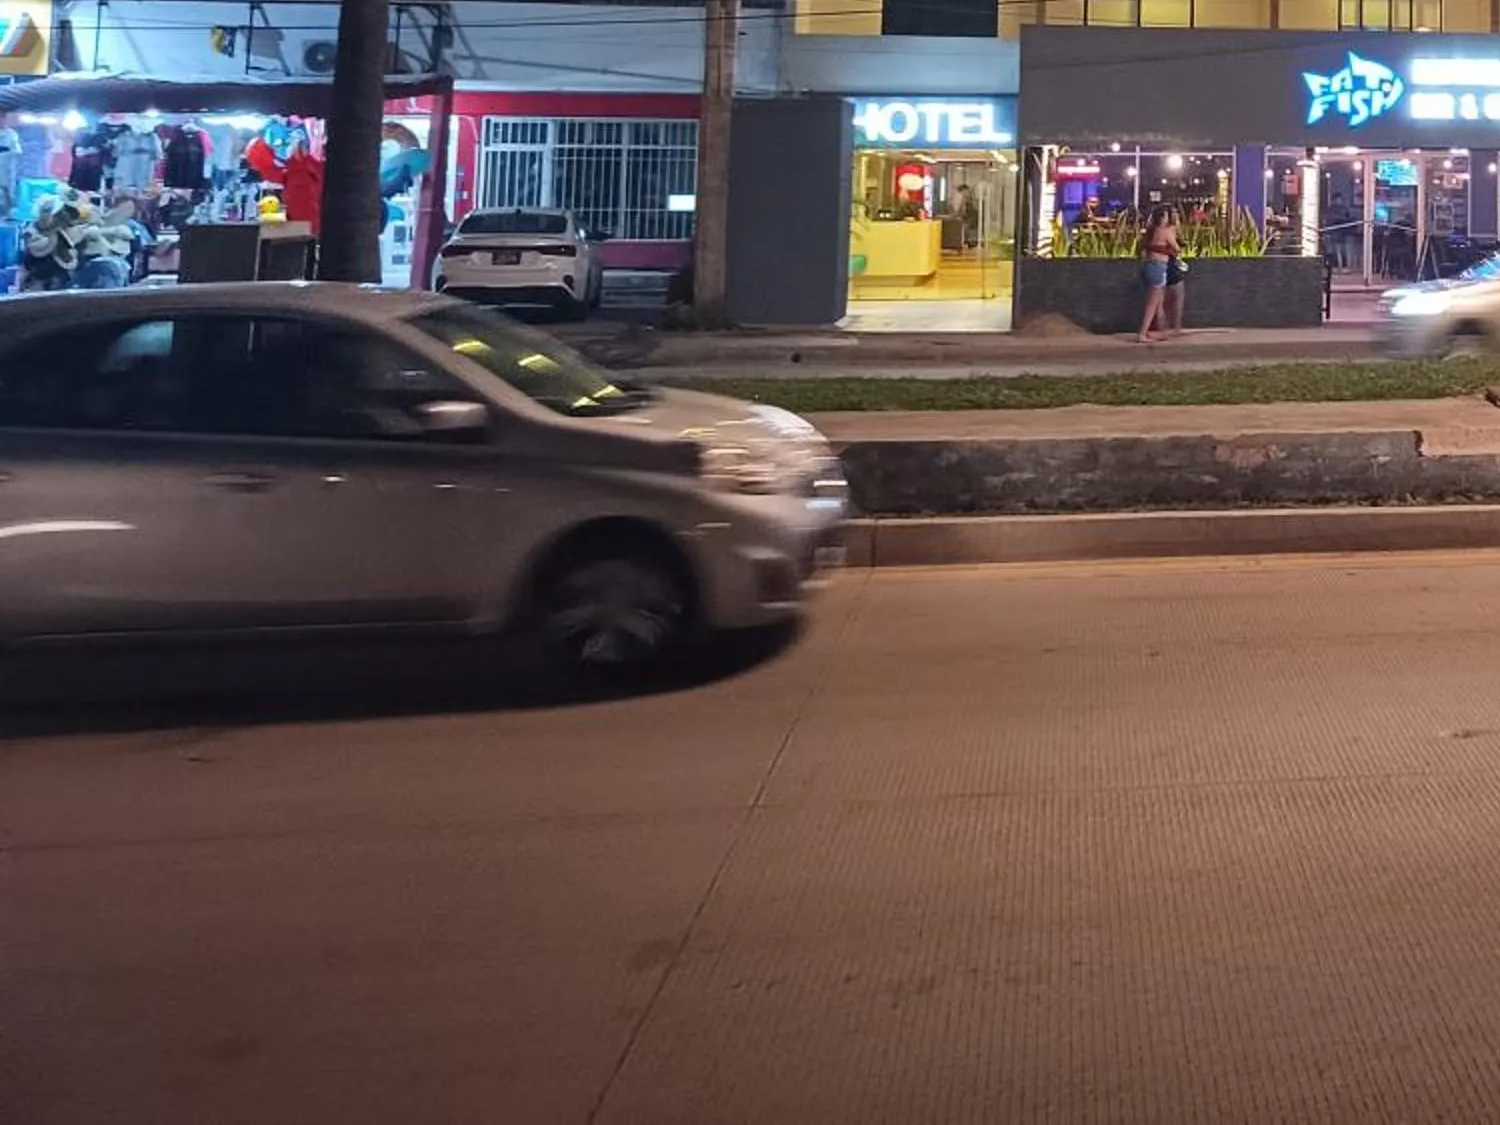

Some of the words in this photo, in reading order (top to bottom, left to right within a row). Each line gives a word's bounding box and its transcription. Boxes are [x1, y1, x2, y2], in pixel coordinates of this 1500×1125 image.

[1303, 51, 1394, 96] FAT
[852, 102, 1013, 142] HOTEL
[1307, 77, 1405, 125] FISH
